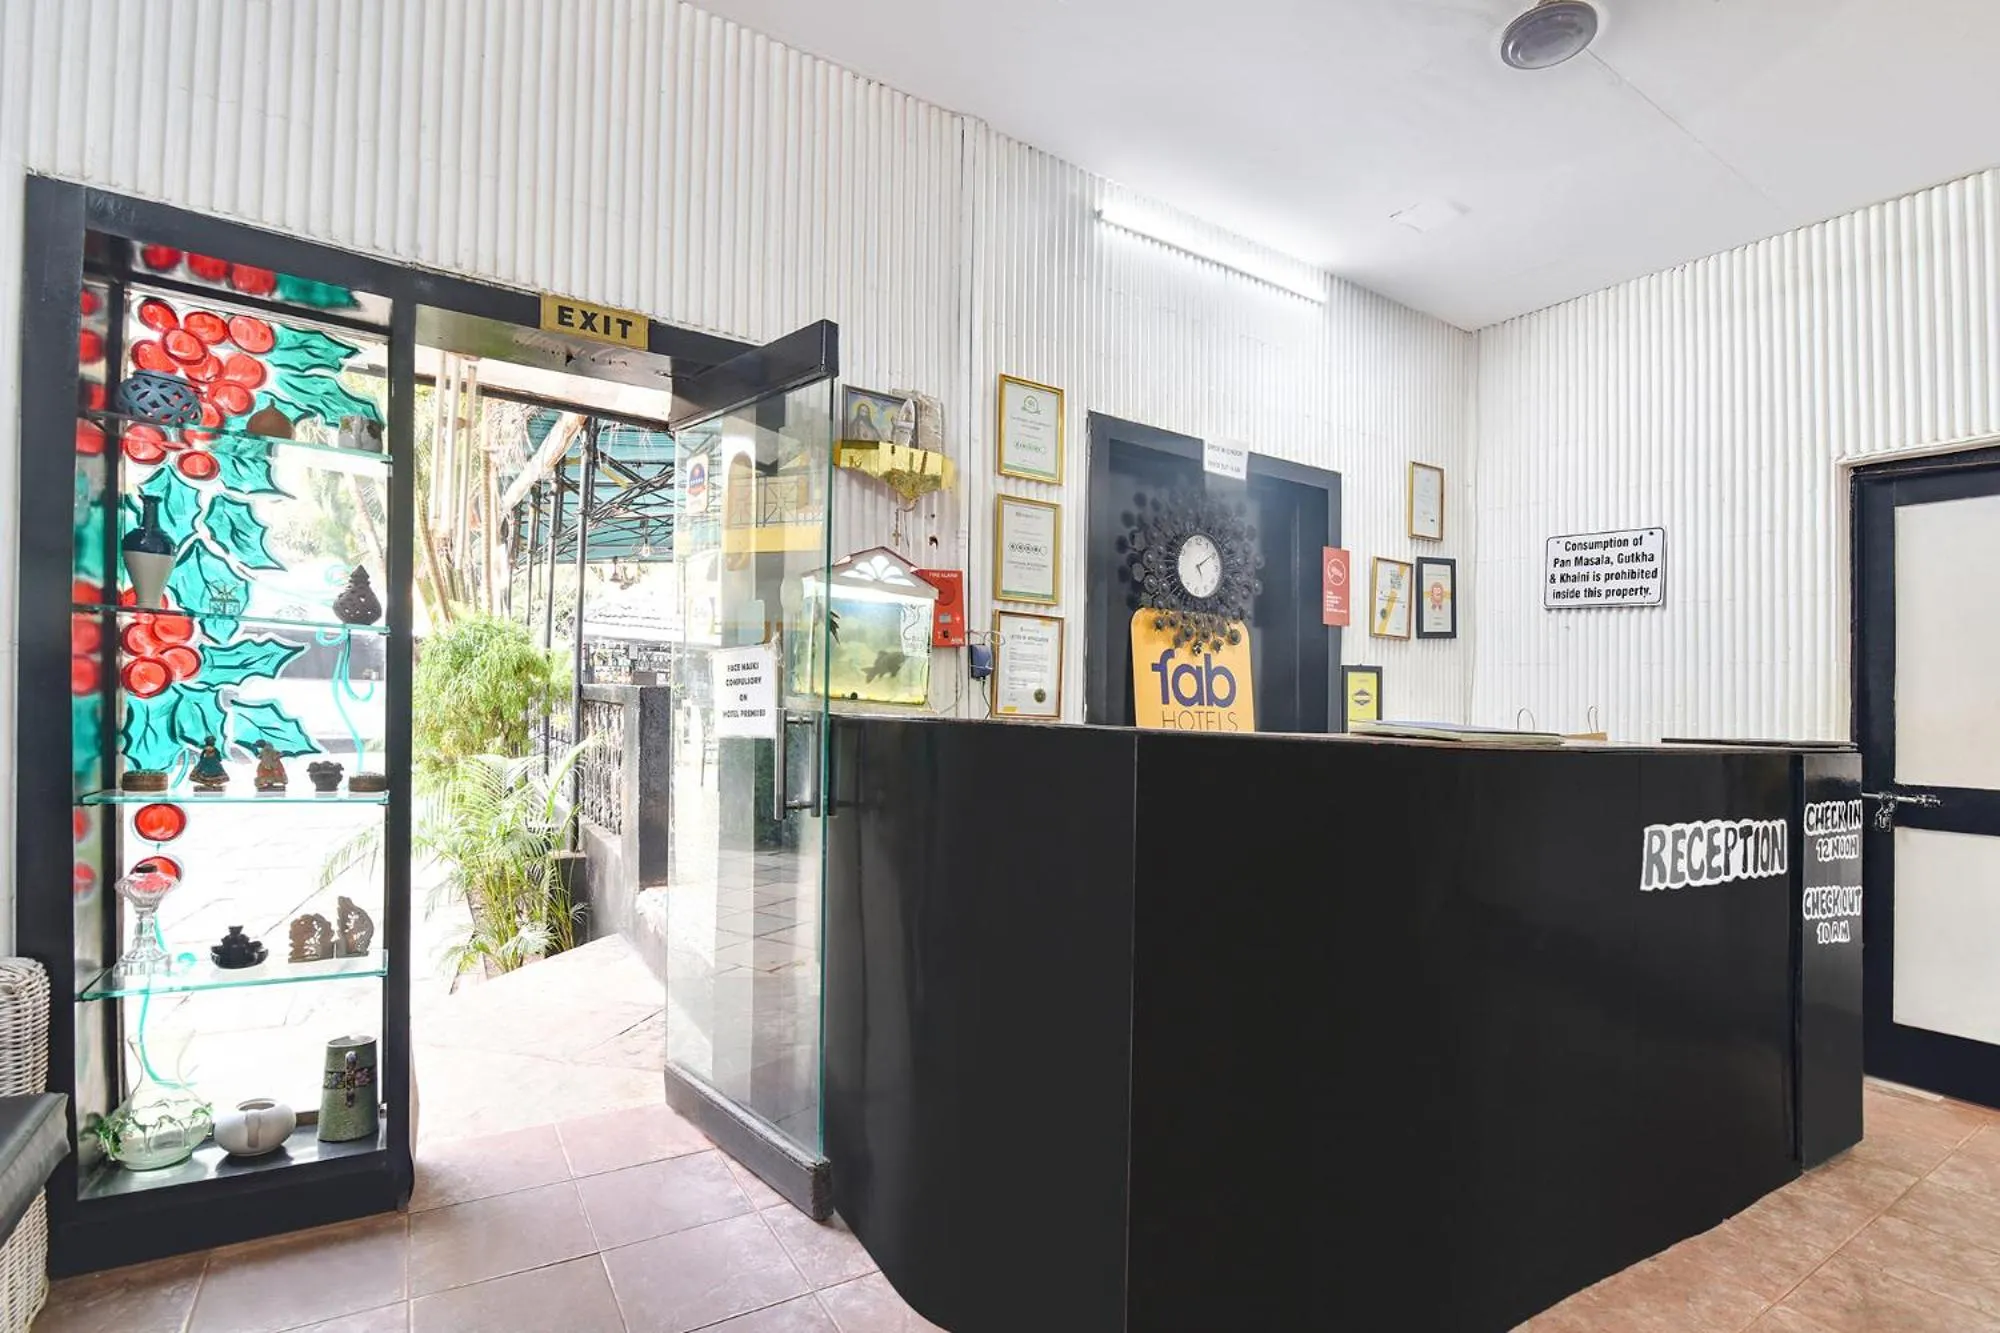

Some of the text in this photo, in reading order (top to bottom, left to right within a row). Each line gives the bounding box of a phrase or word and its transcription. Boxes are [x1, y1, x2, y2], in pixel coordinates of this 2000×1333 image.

[558, 304, 633, 340] EXIT
[1564, 534, 1643, 552] Consumption of
[1553, 551, 1655, 568] Pan Masala, Gutkha
[1549, 567, 1658, 584] & Khaini is prohibited
[1552, 586, 1652, 600] inside this property.
[727, 663, 741, 672] FACE
[1151, 648, 1237, 709] fab
[739, 693, 748, 702] ON
[1803, 799, 1863, 836] CHECK IN
[1641, 819, 1787, 891] RECEPTION
[1816, 835, 1860, 862] 12 NOON
[1816, 920, 1850, 944] 10 AM
